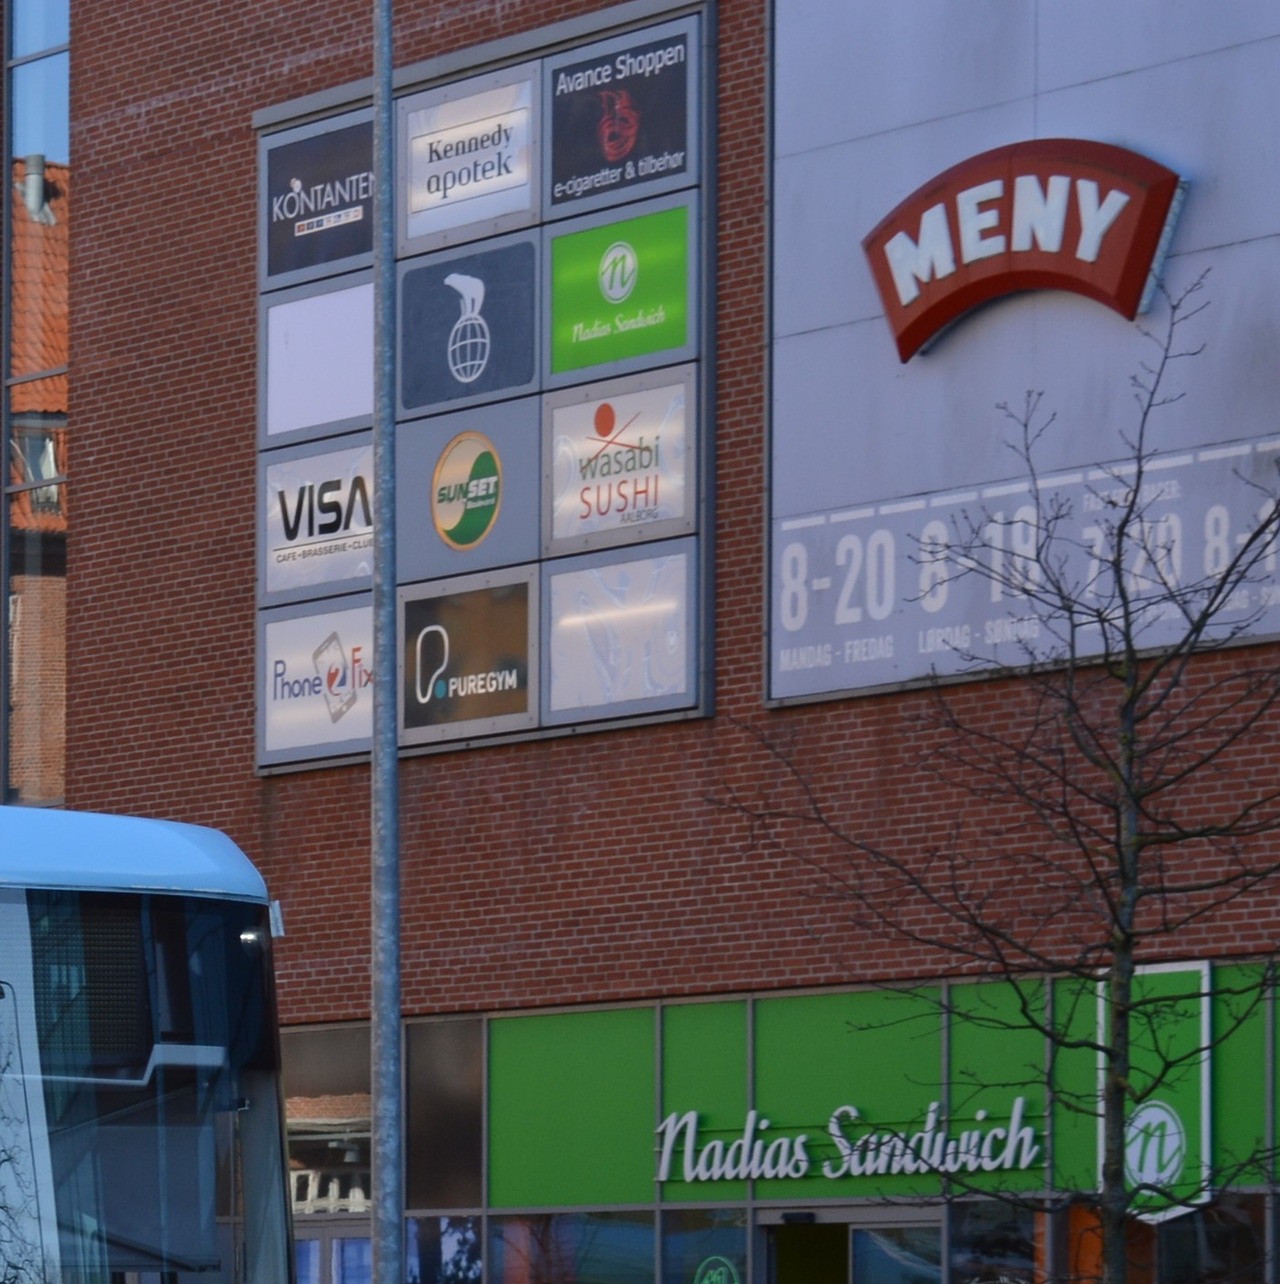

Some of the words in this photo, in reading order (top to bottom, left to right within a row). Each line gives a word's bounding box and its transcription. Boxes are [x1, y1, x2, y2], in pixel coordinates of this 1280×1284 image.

[556, 64, 611, 96] Avance
[615, 42, 685, 83] Shoppen
[427, 123, 513, 164] Kennedy
[426, 150, 513, 199] apotek
[554, 167, 623, 198] e-cigaretter
[884, 174, 1130, 307] MENY
[572, 320, 612, 343] Nadias
[278, 475, 374, 541] VISA
[437, 476, 498, 503] SUNSET
[579, 475, 659, 520] SUSHI
[780, 528, 895, 631] 8-20
[273, 659, 323, 701] Phone
[448, 669, 518, 698] PUREGYM
[656, 1109, 809, 1183] Nadias
[823, 1097, 1039, 1179] Sandwich
